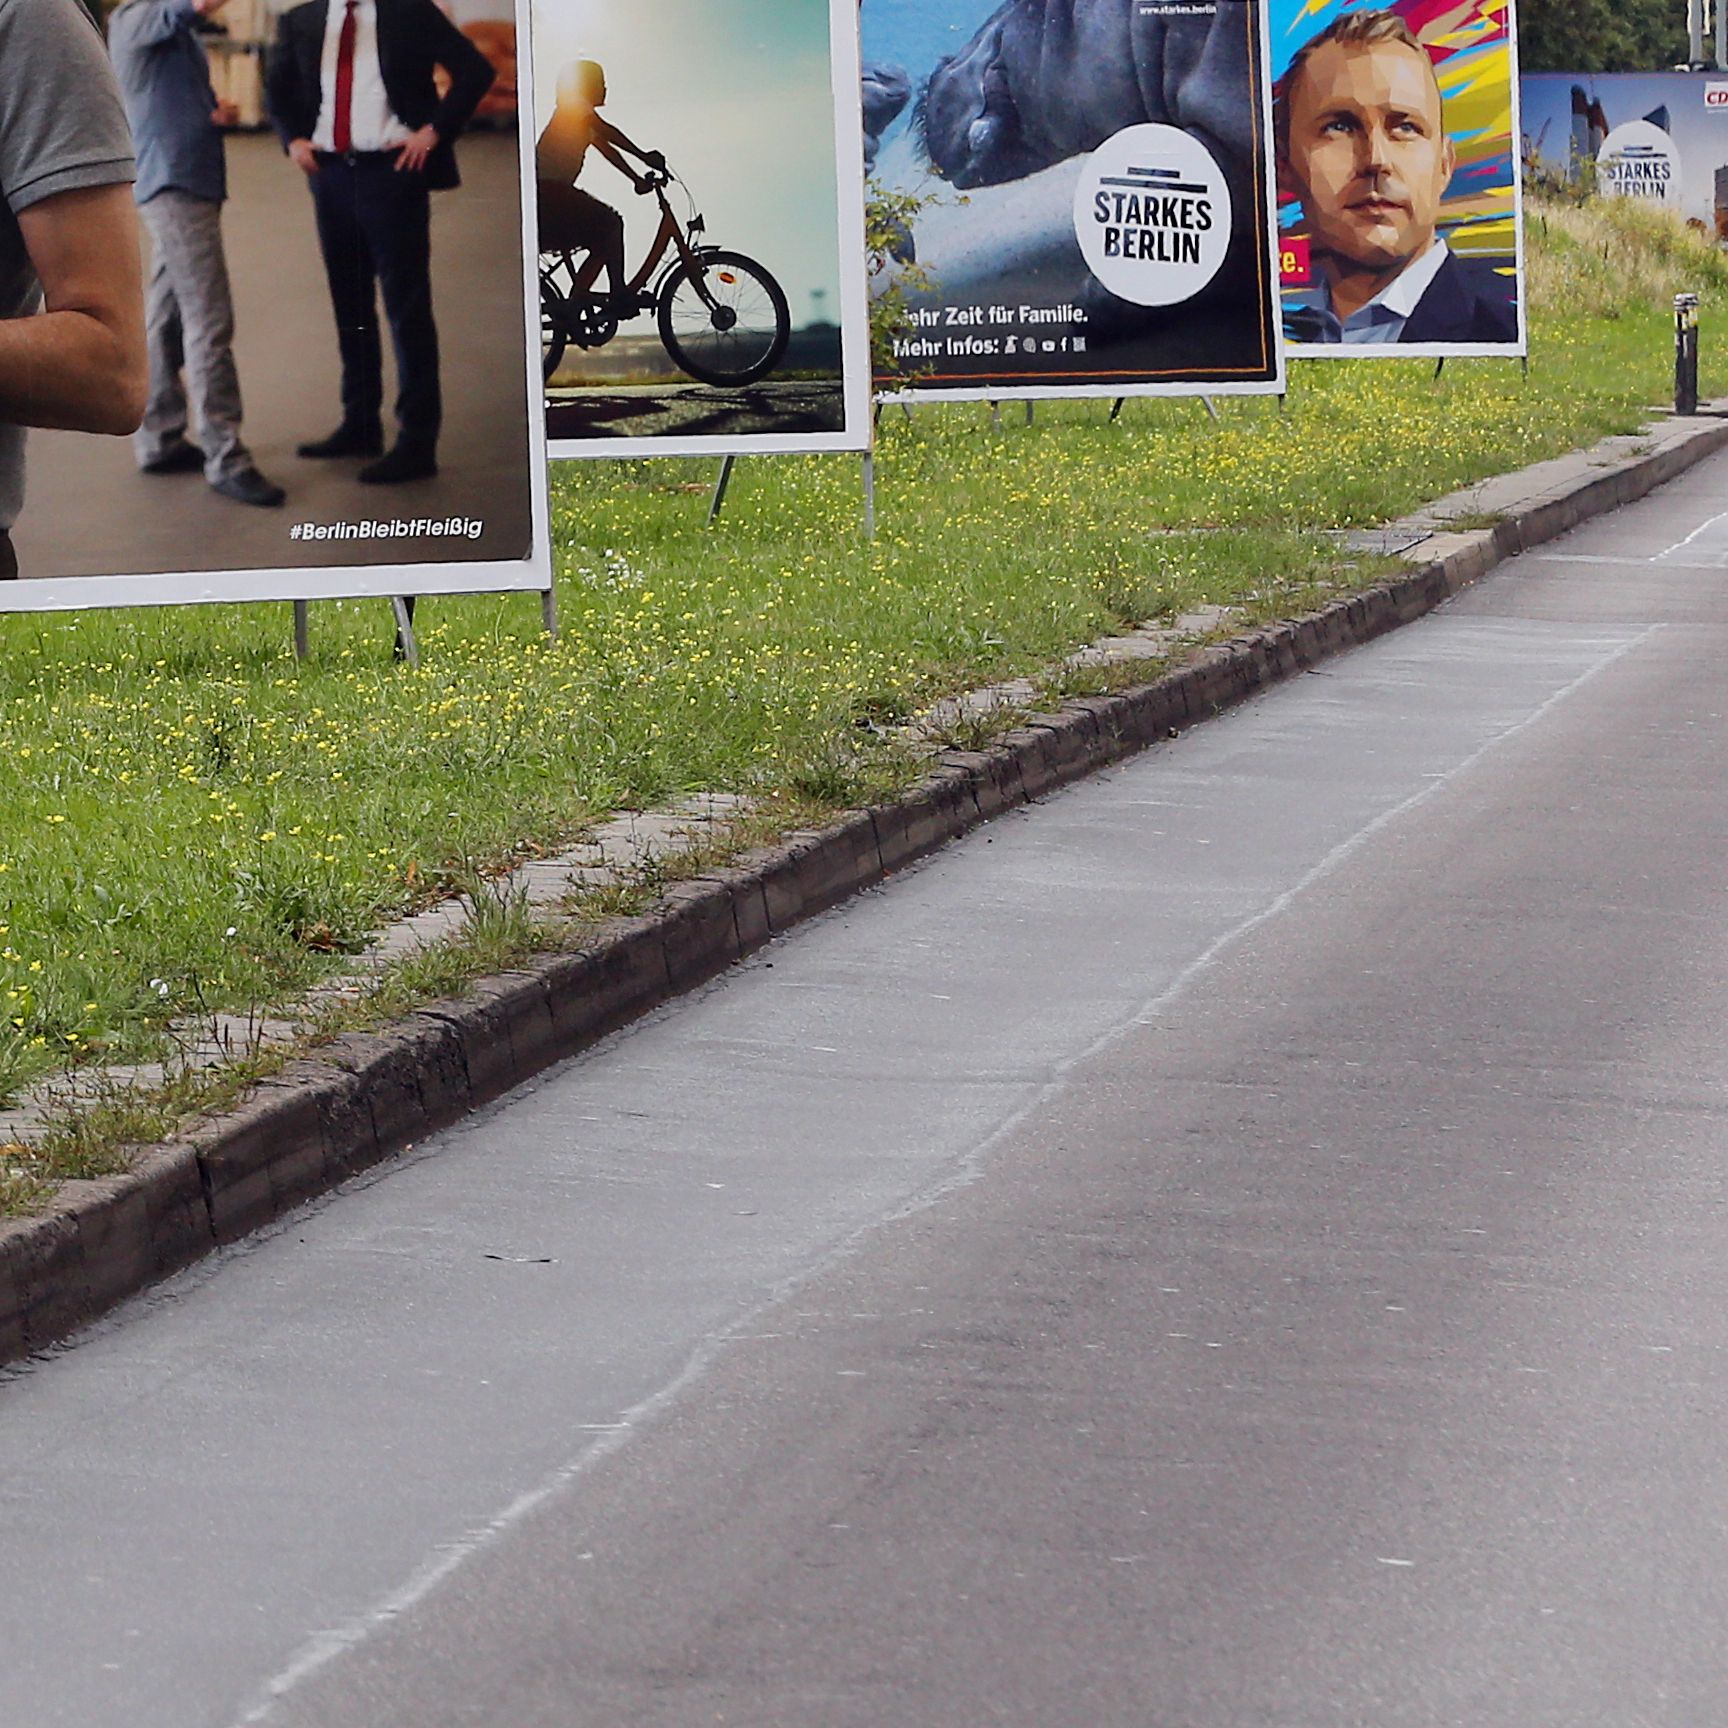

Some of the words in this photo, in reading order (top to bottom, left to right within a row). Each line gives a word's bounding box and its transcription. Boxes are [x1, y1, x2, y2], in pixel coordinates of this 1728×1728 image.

[1094, 190, 1212, 231] STARKES
[1104, 227, 1200, 264] BERLIN
[1279, 251, 1304, 273] e.
[945, 305, 983, 325] Zeit
[988, 305, 1015, 324] für
[1018, 304, 1089, 323] Familie.
[893, 336, 942, 357] Mehr
[947, 335, 999, 355] Infos:
[290, 518, 482, 540] #BerlinBleibtFleißig
